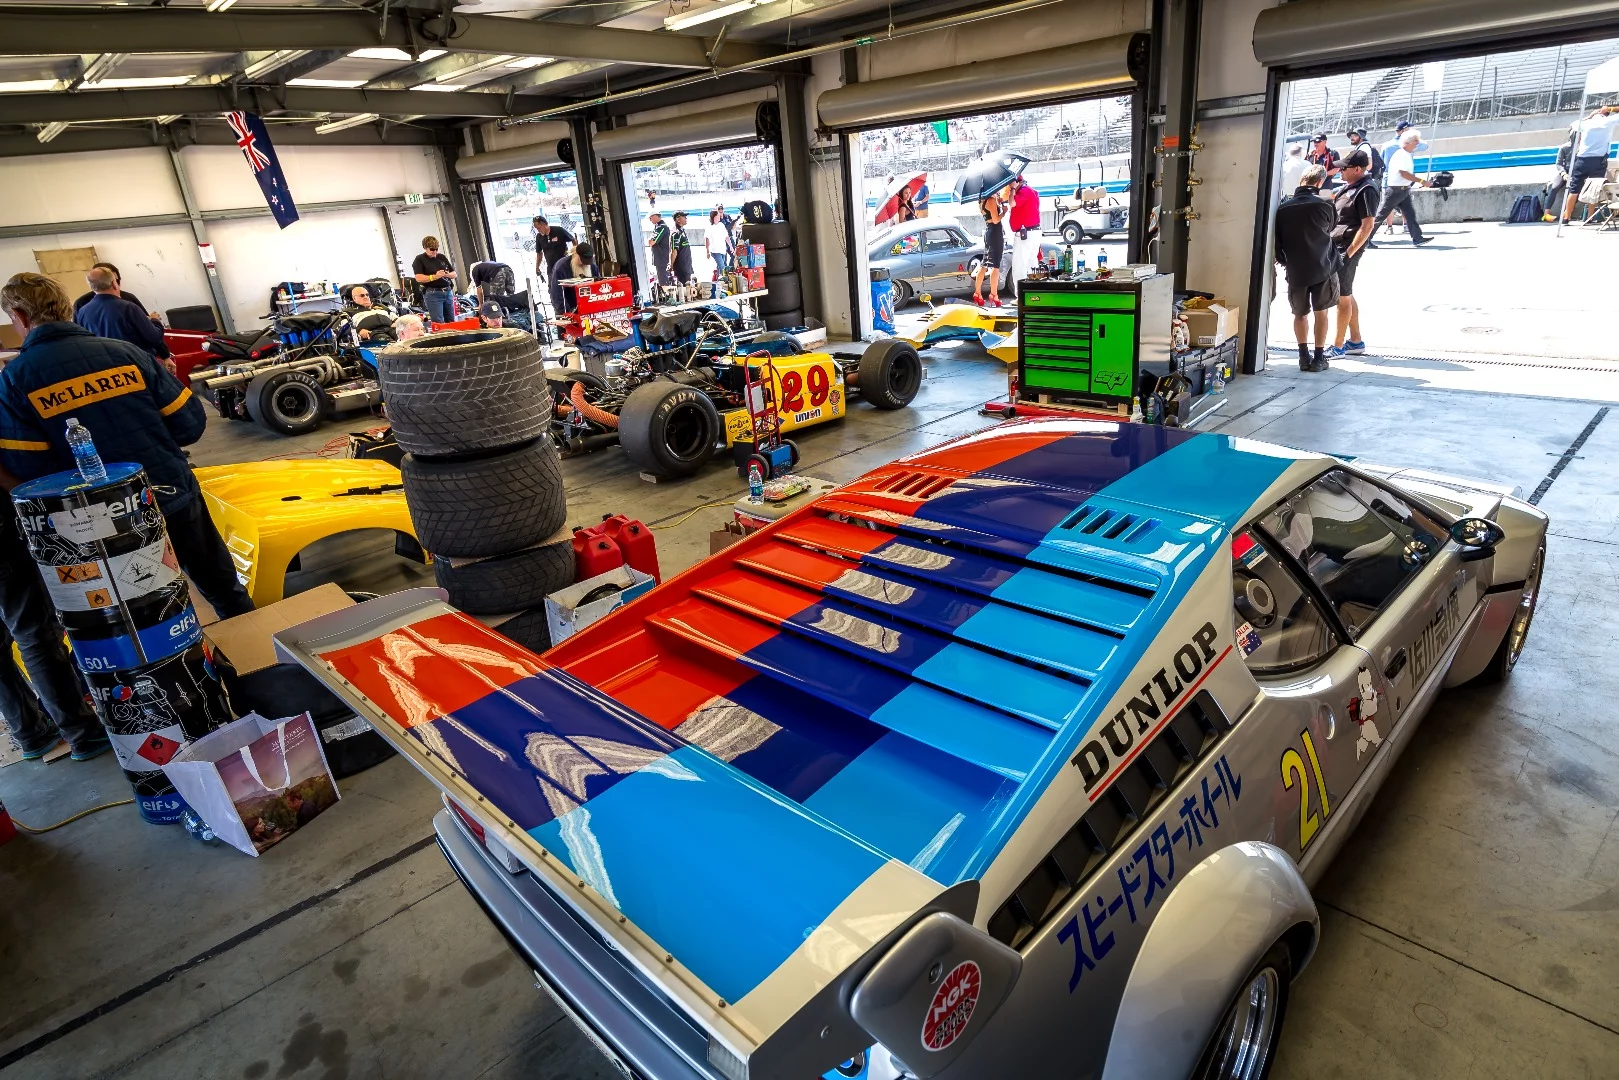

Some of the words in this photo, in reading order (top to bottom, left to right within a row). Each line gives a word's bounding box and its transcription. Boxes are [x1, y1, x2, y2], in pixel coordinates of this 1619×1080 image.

[408, 193, 422, 203] EXIT
[587, 290, 626, 303] Snap-on
[286, 374, 319, 390] AVON
[781, 364, 830, 414] 29
[661, 391, 697, 413] AVON
[107, 492, 141, 517] elf
[22, 514, 45, 533] elf
[169, 615, 190, 637] elf
[84, 656, 101, 670] 50
[1070, 621, 1218, 795] DUNLOP
[1280, 726, 1331, 853] 21
[142, 800, 164, 812] elf
[1056, 753, 1242, 995] スピードスターホイール
[933, 971, 971, 1024] NGK
[934, 1002, 973, 1047] PLUGS
[935, 995, 972, 1034] SPARK
